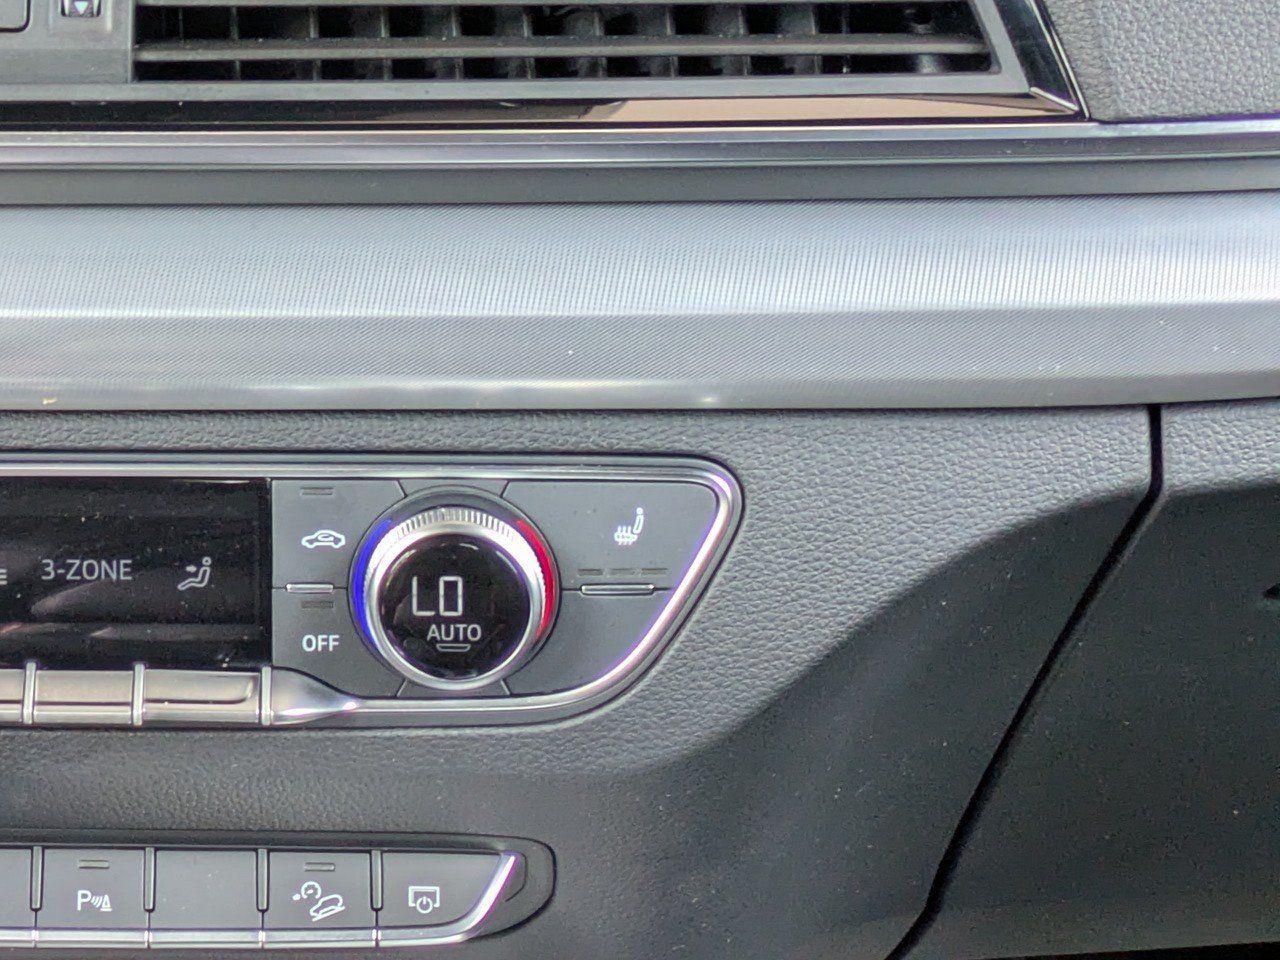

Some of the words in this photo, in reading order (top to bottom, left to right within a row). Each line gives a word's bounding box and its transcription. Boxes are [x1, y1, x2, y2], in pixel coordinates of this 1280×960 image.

[40, 559, 133, 581] 3-ZONE
[427, 623, 482, 641] AUTO
[301, 634, 340, 652] OFF
